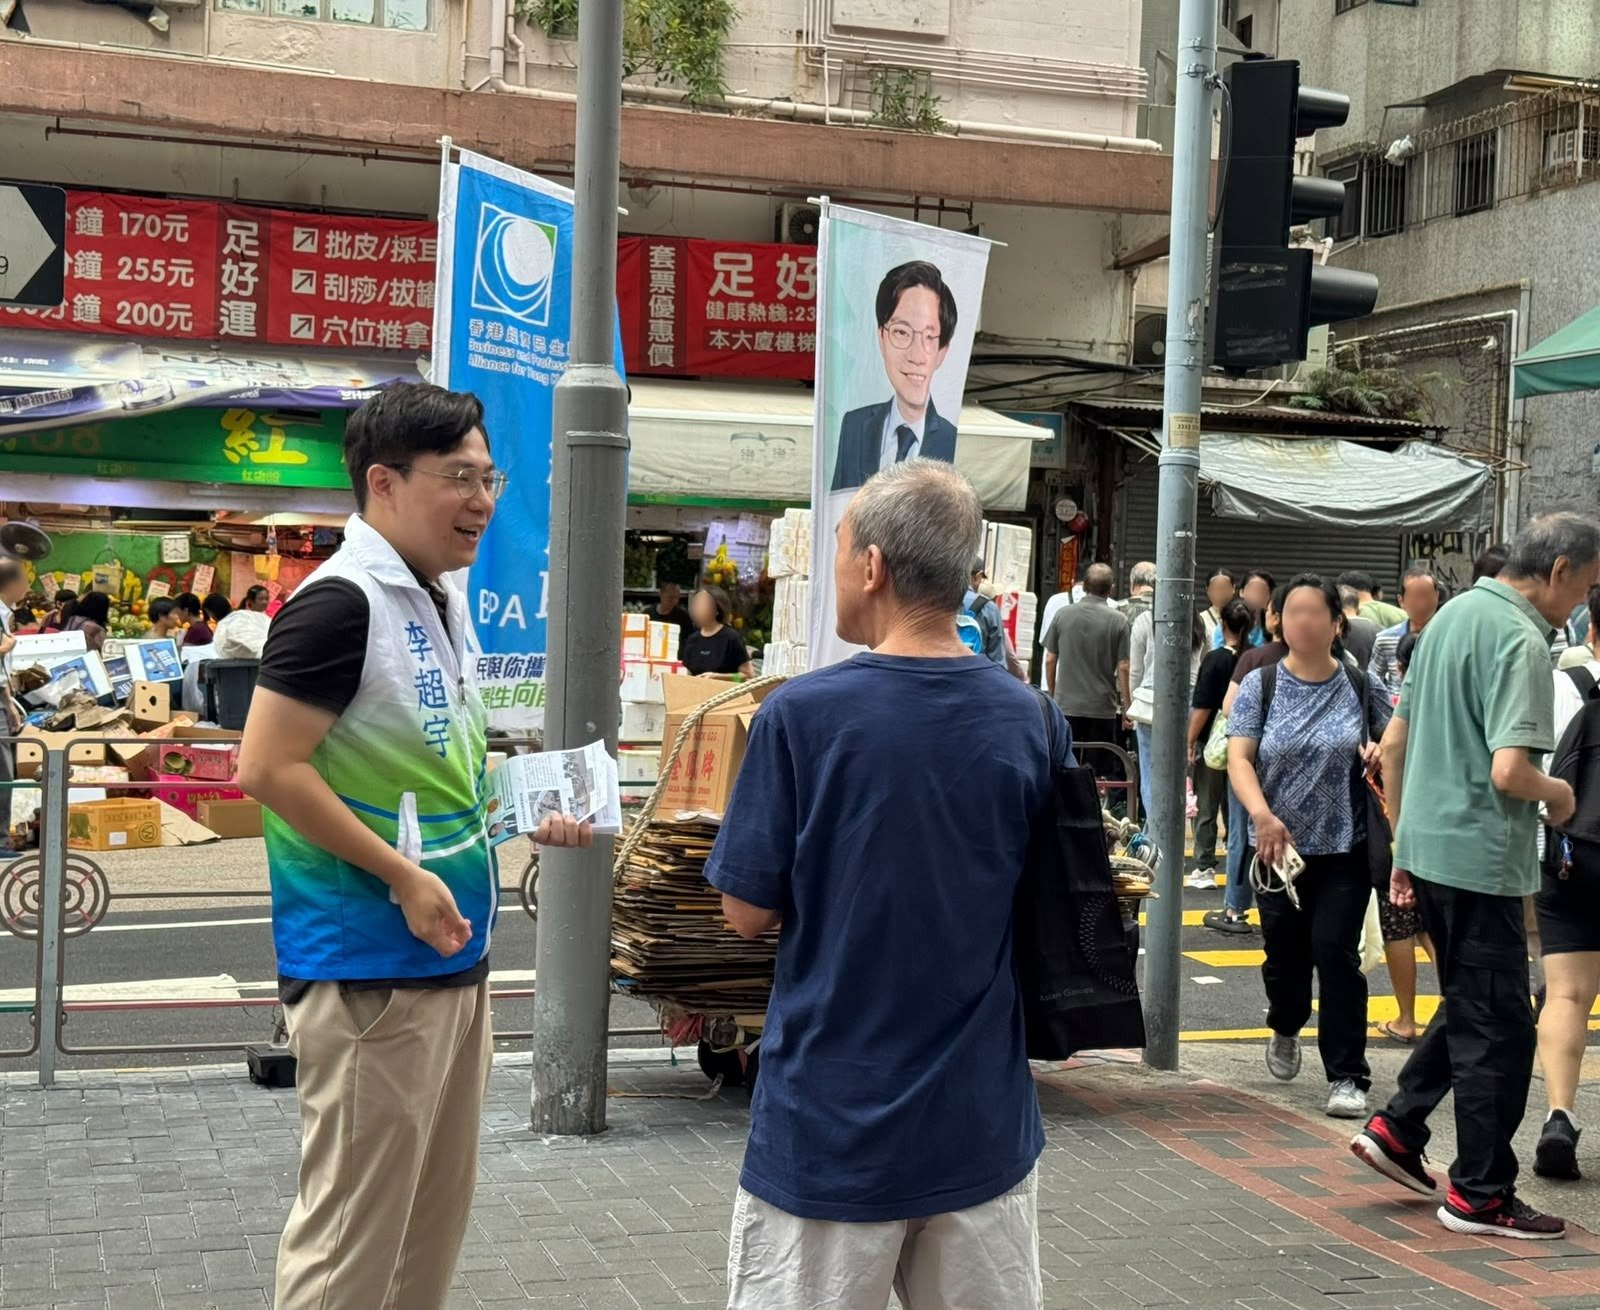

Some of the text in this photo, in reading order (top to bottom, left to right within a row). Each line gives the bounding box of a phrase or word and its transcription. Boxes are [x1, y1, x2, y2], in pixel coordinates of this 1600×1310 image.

[66, 206, 189, 243] 鐘 170元
[117, 256, 194, 288] 255元
[218, 219, 260, 338] 足好運
[116, 301, 193, 332] 200元
[648, 245, 676, 368] 套票優惠價
[322, 315, 431, 349] 穴位推拿
[468, 338, 515, 359] Business
[468, 353, 510, 374] Alliance
[404, 620, 451, 759] 李超宇
